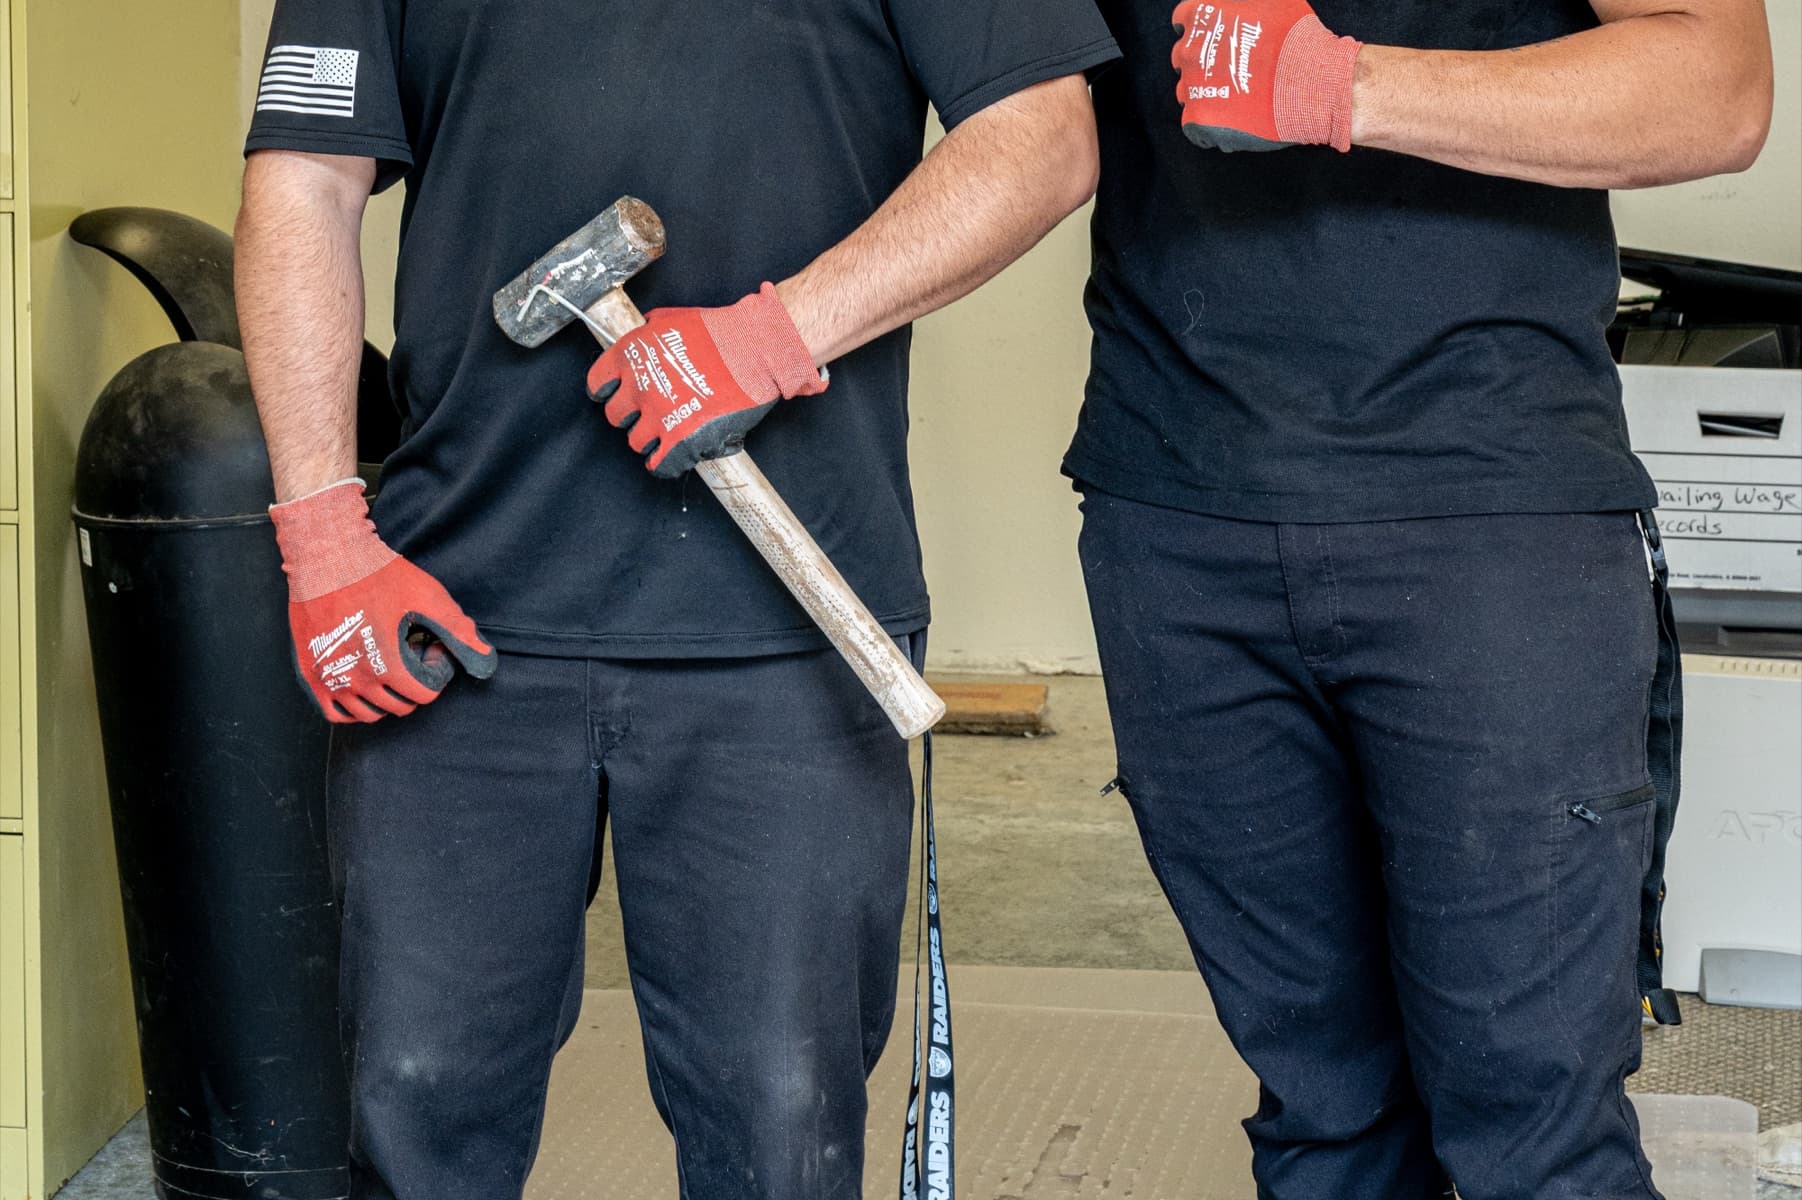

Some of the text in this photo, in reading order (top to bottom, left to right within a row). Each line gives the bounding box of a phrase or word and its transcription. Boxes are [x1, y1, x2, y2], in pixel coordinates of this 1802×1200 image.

[1215, 24, 1225, 42] CUT
[1238, 20, 1262, 94] Milwaukee
[649, 346, 660, 364] CUT
[661, 327, 712, 396] Milwaukee
[1735, 487, 1801, 511] Wage
[308, 609, 362, 659] Milwaukee
[930, 927, 950, 1045] RAIDERS
